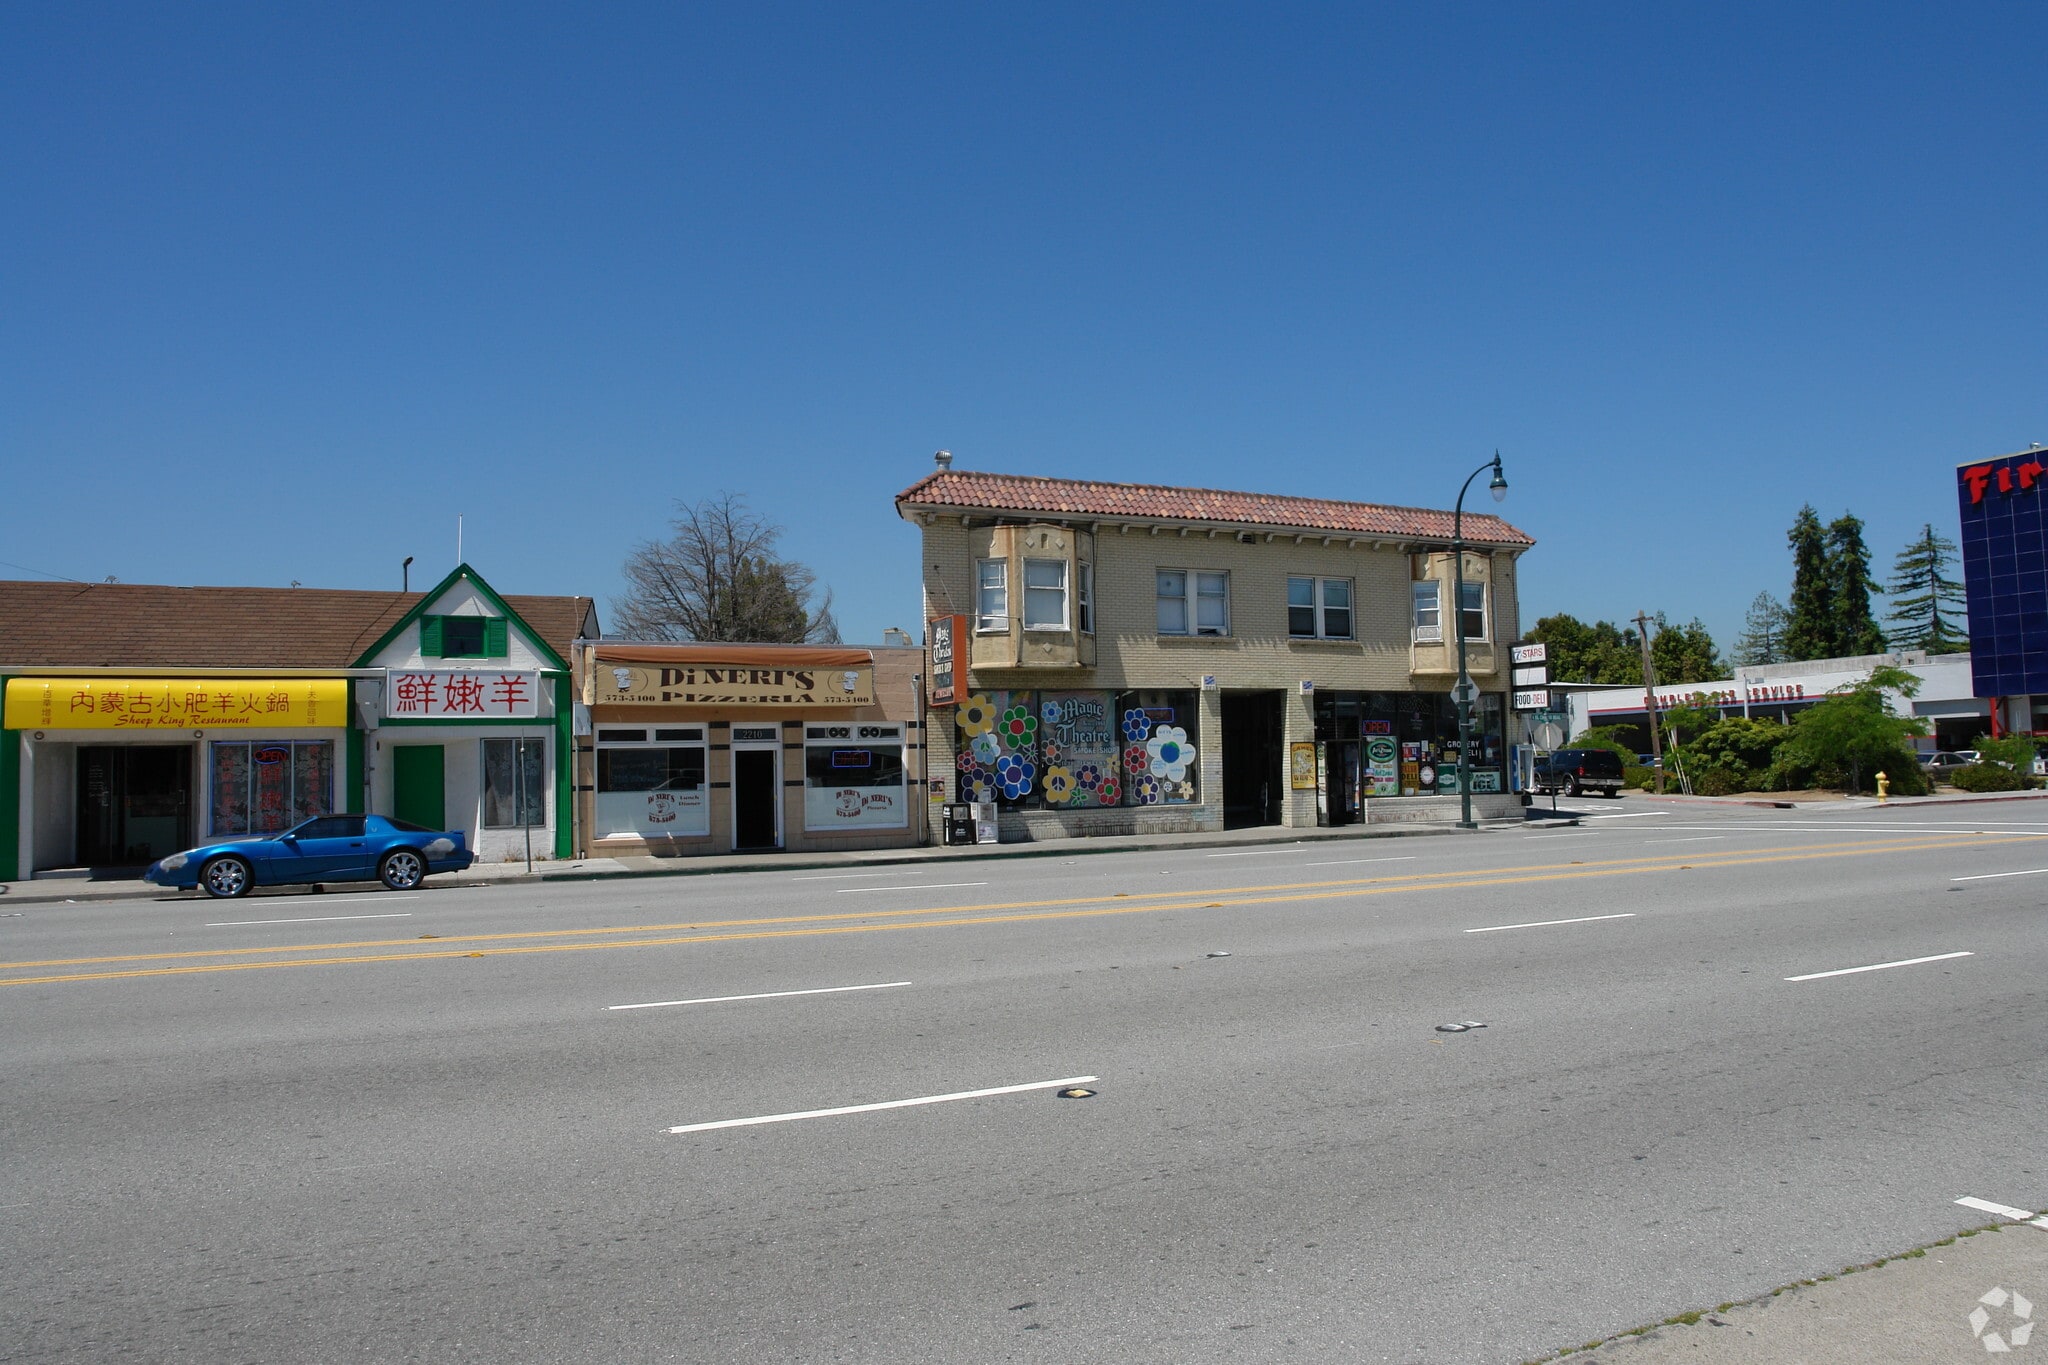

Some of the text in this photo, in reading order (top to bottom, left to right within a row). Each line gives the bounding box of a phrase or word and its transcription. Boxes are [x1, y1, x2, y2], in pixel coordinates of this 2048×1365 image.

[1522, 648, 1543, 658] STARS
[660, 668, 815, 690] Di NERI'S
[396, 674, 529, 713] 鮮嫩羊
[1747, 684, 1803, 697] ERVICE
[70, 691, 289, 714] 內蒙古小肥羊火鍋
[662, 691, 816, 703] PIZZERIA
[1515, 693, 1545, 704] FOOD DELI
[1062, 699, 1104, 721] Magic
[114, 714, 250, 728] Sheep King Restaurant
[1365, 721, 1388, 733] OPEN
[743, 730, 762, 739] 2210
[1055, 719, 1110, 747] Theatre
[1447, 740, 1480, 748] GROERY
[254, 750, 287, 761] OPEN
